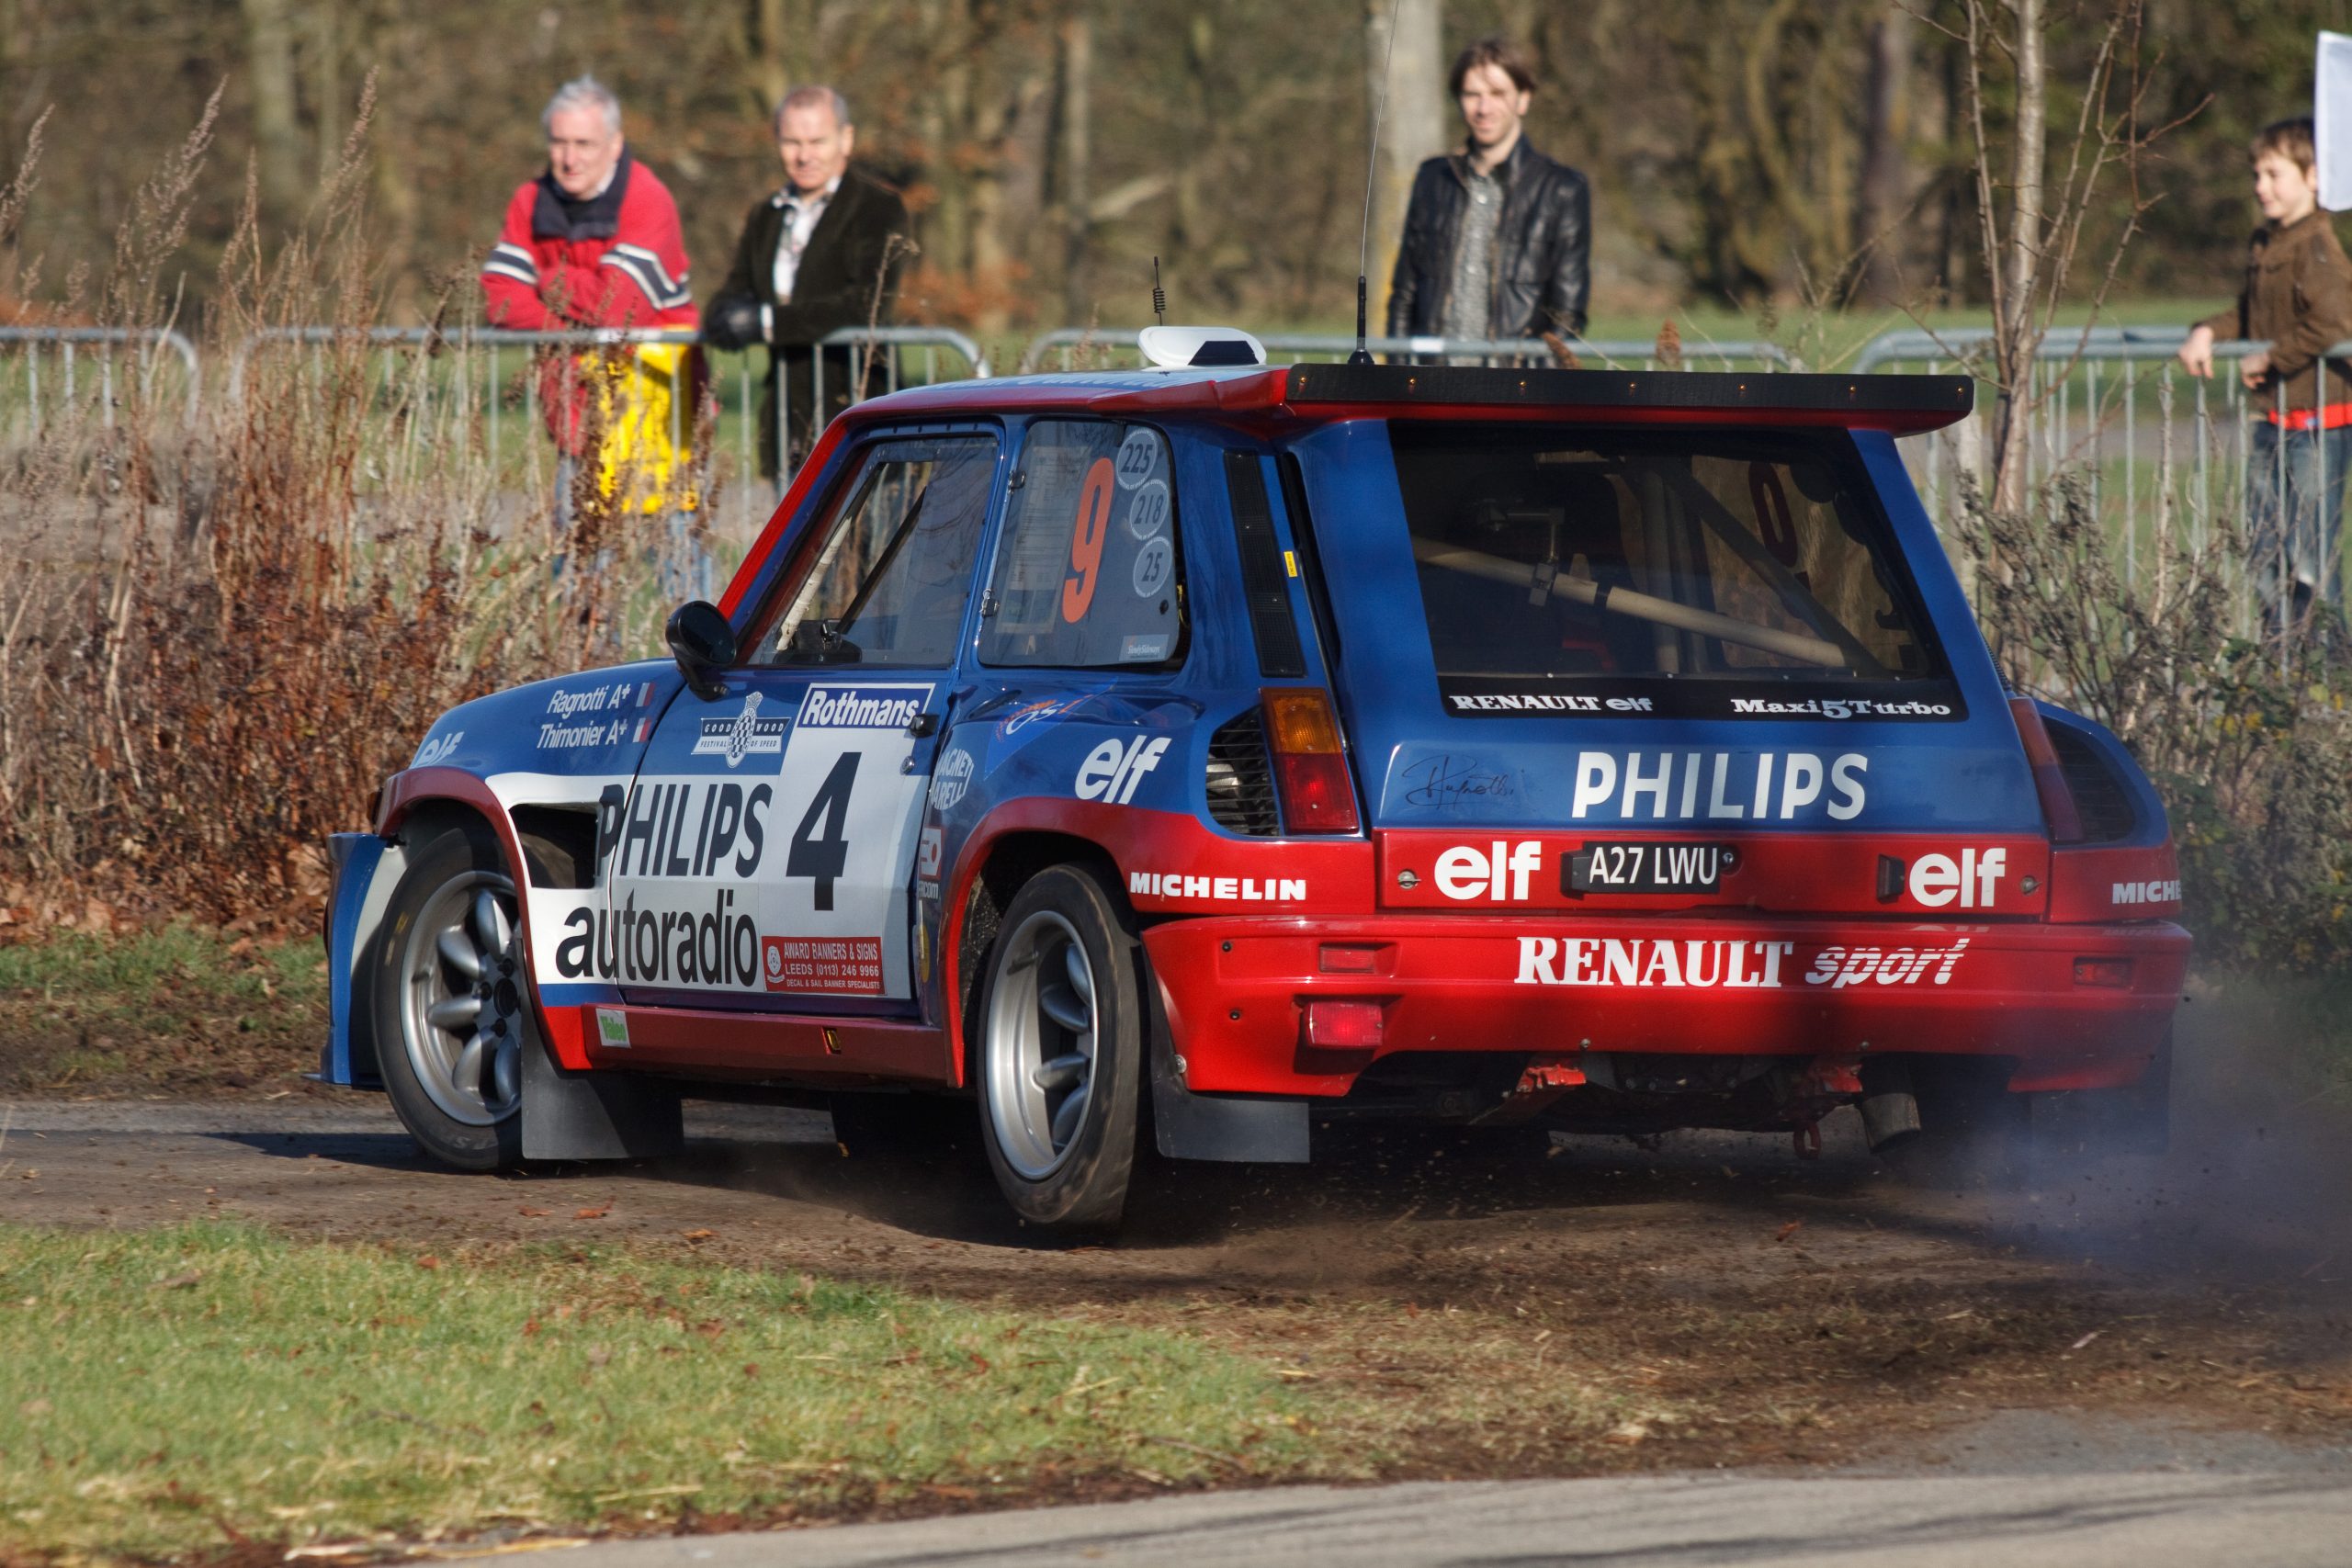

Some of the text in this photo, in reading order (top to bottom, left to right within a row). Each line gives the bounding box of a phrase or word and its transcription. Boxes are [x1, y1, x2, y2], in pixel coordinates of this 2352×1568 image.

[1120, 443, 1153, 474] 225
[1062, 457, 1114, 624] 9
[1142, 552, 1163, 582] 25
[547, 685, 608, 718] Ragnotti
[802, 691, 920, 728] Rothmans
[1449, 695, 1653, 711] RENAULT elf
[414, 731, 465, 767] elf
[537, 720, 605, 749] Thimonier
[700, 739, 727, 748] FESTIVAL
[760, 739, 777, 748] SPEED
[1075, 735, 1172, 805] elf
[1572, 751, 1868, 820] PHILIPS
[598, 783, 773, 878] PHILIPS
[786, 751, 862, 911] 4
[1434, 840, 1542, 901] elf
[1589, 846, 1718, 885] A27 LWU
[1909, 847, 2007, 908] elf
[1130, 872, 1306, 901] MICHELIN
[555, 888, 758, 987] autoradio
[784, 942, 878, 961] AWARD BANNERS & SIGNS
[785, 964, 879, 976] LEEDS (0113) 246 9966
[1514, 936, 1971, 989] RENAULT sport
[824, 980, 846, 988] BANNER
[847, 980, 880, 989] SPECIALISTS
